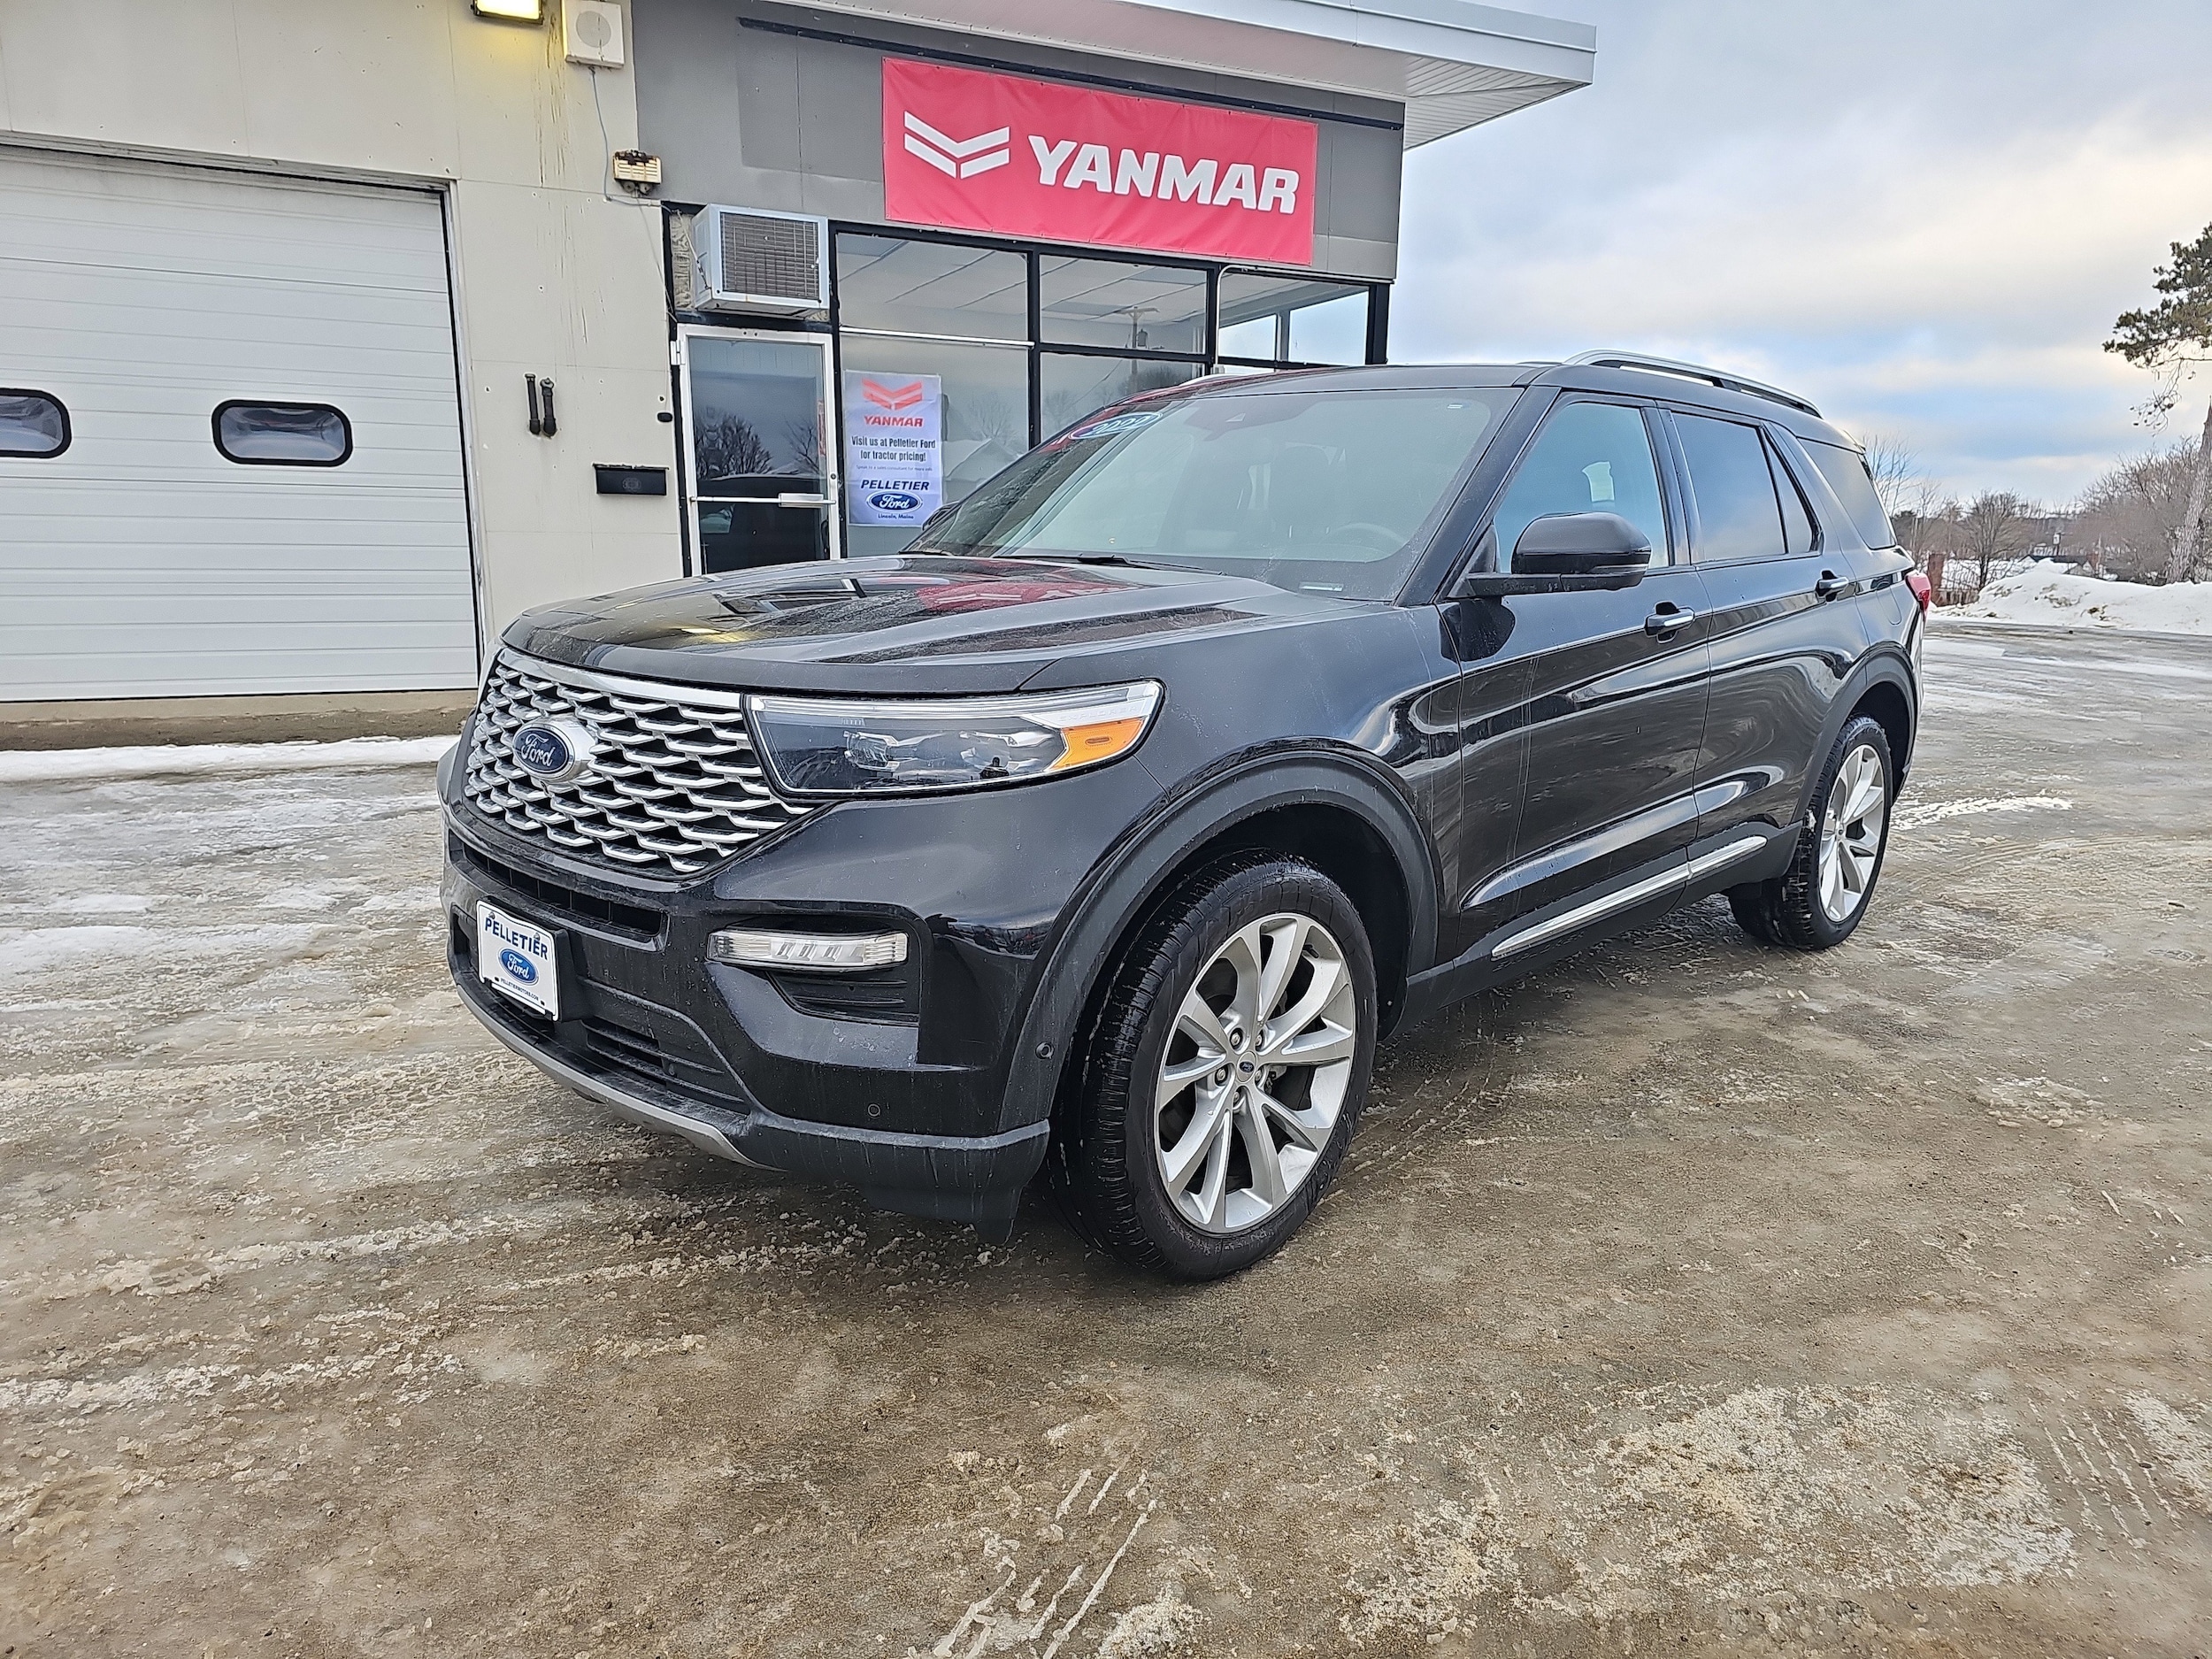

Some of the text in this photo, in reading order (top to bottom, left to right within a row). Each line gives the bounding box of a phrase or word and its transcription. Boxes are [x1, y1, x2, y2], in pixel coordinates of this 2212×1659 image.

[1028, 134, 1300, 215] YANMAR
[864, 415, 924, 427] YANMAR
[851, 435, 868, 446] Visit
[879, 438, 887, 447] at
[888, 438, 919, 449] Pelletier
[920, 440, 936, 449] Ford
[860, 450, 926, 462] for tractor pricing!
[860, 479, 930, 491] PELLETIER
[879, 495, 910, 509] Ford
[1059, 705, 1138, 722] EXPLORER
[520, 733, 556, 767] Ford
[484, 918, 548, 961] PELLETIER
[507, 953, 530, 979] Ford
